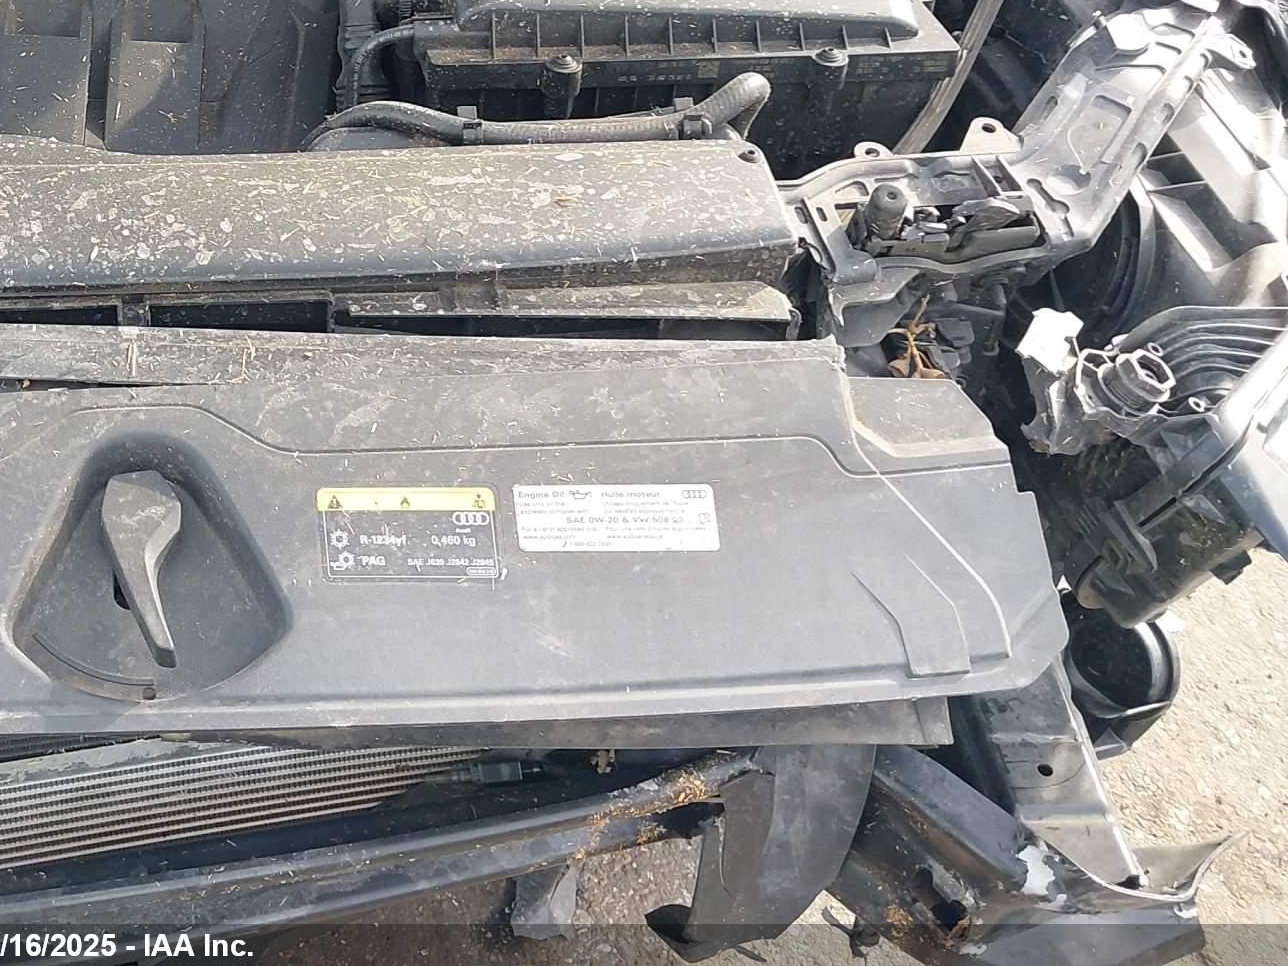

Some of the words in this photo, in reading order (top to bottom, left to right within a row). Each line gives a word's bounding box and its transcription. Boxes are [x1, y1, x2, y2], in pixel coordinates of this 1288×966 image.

[518, 491, 550, 500] Engine
[566, 516, 585, 524] SAE
[622, 516, 630, 524] &
[632, 516, 649, 524] VW
[359, 535, 407, 547] R-1234yf
[430, 535, 460, 547] 0,460
[463, 535, 476, 547] kg
[361, 555, 386, 566] PAG
[407, 558, 425, 567] SAE
